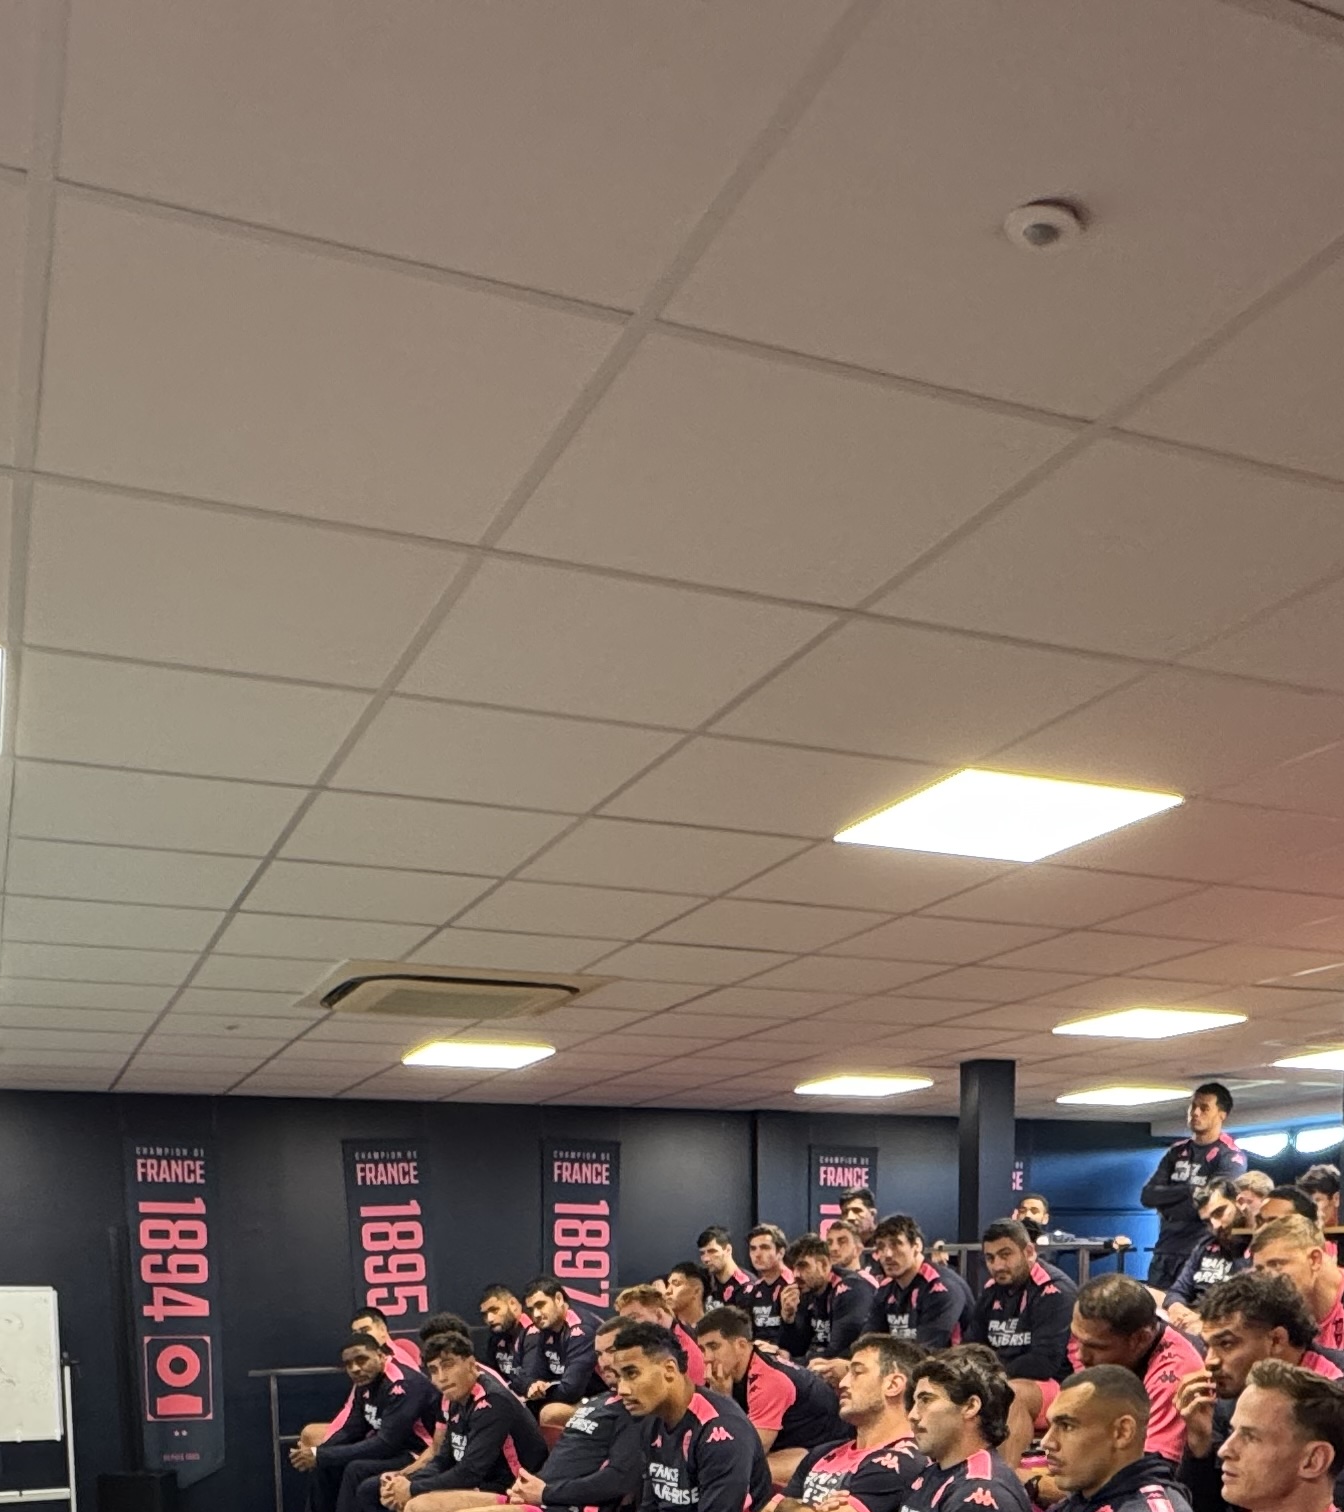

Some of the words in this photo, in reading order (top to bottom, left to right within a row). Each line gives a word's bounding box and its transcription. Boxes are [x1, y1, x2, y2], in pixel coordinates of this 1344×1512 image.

[136, 1158, 206, 1184] FRANCE
[356, 1162, 419, 1185] FRANCE
[553, 1161, 610, 1185] FRANCE
[819, 1166, 869, 1188] FRANCE
[138, 1196, 210, 1323] 1894
[359, 1199, 429, 1317] 1895
[553, 1200, 610, 1309] 1897
